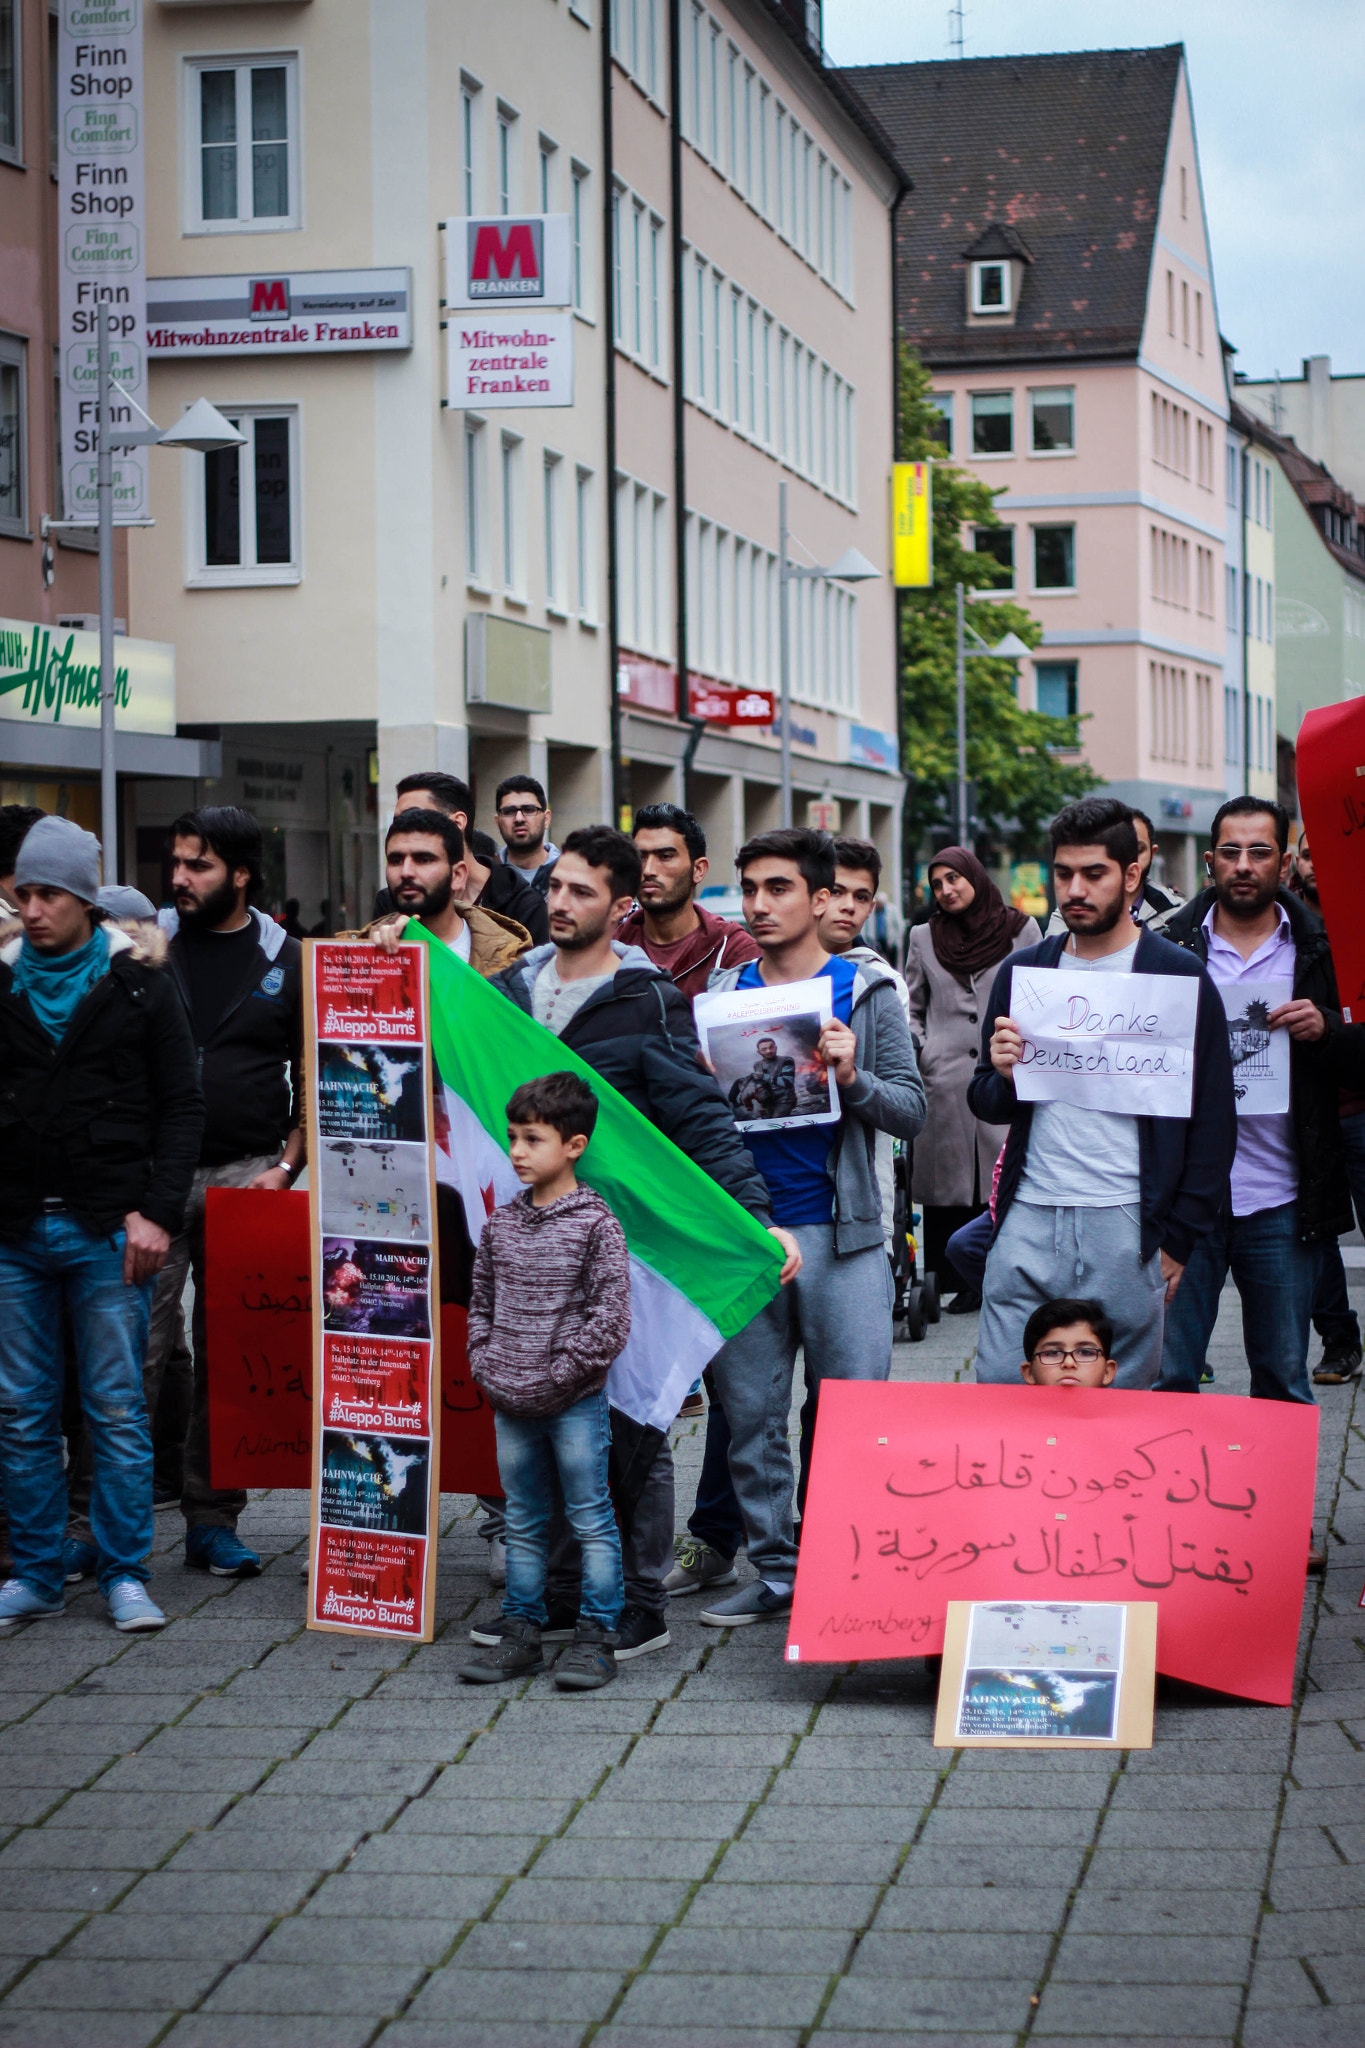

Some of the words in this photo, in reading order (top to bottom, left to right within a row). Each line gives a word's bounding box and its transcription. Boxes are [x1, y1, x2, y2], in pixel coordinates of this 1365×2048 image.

[70, 7, 130, 25] Comfort
[75, 45, 127, 67] Finn
[70, 73, 133, 99] Shop
[84, 110, 118, 126] Finn
[71, 125, 131, 143] Comfort
[76, 163, 128, 185] Finn
[71, 191, 134, 218] Shop
[85, 229, 119, 244] Finn
[72, 244, 133, 261] Comfort
[471, 225, 539, 279] M
[77, 282, 129, 305] Finn
[251, 281, 288, 312] M
[470, 280, 540, 295] FRANKEN
[302, 300, 356, 311] Vermietung
[359, 299, 376, 308] auf
[378, 298, 396, 307] Zeit
[147, 324, 309, 349] Mitwohnzentrale
[315, 321, 399, 342] Franken
[460, 329, 556, 349] Mitwohn-
[469, 352, 549, 371] zentrale
[73, 364, 134, 381] Coort
[467, 375, 550, 394] Franken
[76, 484, 136, 500] Coort
[10, 626, 132, 722] Hofman
[323, 965, 351, 976] Hallplatz
[352, 966, 358, 974] in
[359, 966, 370, 975] der
[371, 966, 402, 976] Innenstadt
[323, 985, 342, 993] 90402
[344, 985, 373, 996] Nürnberg
[1056, 995, 1163, 1038] Danke,
[324, 1019, 377, 1037] #Aleppo
[379, 1020, 416, 1035] Burns
[1017, 1038, 1171, 1074] Deutschland
[375, 1254, 428, 1265] MAHNWACHE
[360, 1282, 384, 1292] Hallplatz
[392, 1284, 401, 1292] der
[360, 1297, 377, 1305] 90402
[379, 1300, 404, 1310] Nürnberg
[343, 1345, 379, 1356] 15.10.2016,
[331, 1355, 359, 1365] Hallplatz
[360, 1357, 367, 1365] in
[368, 1358, 378, 1366] der
[380, 1359, 411, 1369] Innenstadt
[331, 1374, 350, 1383] 90402
[352, 1375, 380, 1387] Nürnberg
[329, 1408, 382, 1427] #Aleppo
[384, 1412, 422, 1429] Burns
[234, 1432, 313, 1460] Nürnb
[1166, 1444, 1257, 1519] بان
[343, 1498, 353, 1506] der
[339, 1538, 375, 1551] 15.10.2016,
[1012, 1514, 1139, 1577] أطفال
[327, 1548, 354, 1559] Hallplatz
[355, 1551, 362, 1560] in
[363, 1552, 373, 1561] der
[375, 1553, 406, 1565] Innenstadt
[1132, 1523, 1254, 1596] يقتل
[326, 1567, 345, 1577] 90402
[347, 1568, 375, 1582] Nürnberg
[323, 1601, 376, 1622] #Aleppo
[379, 1607, 414, 1626] Burns
[818, 1607, 940, 1643] Nürnberg
